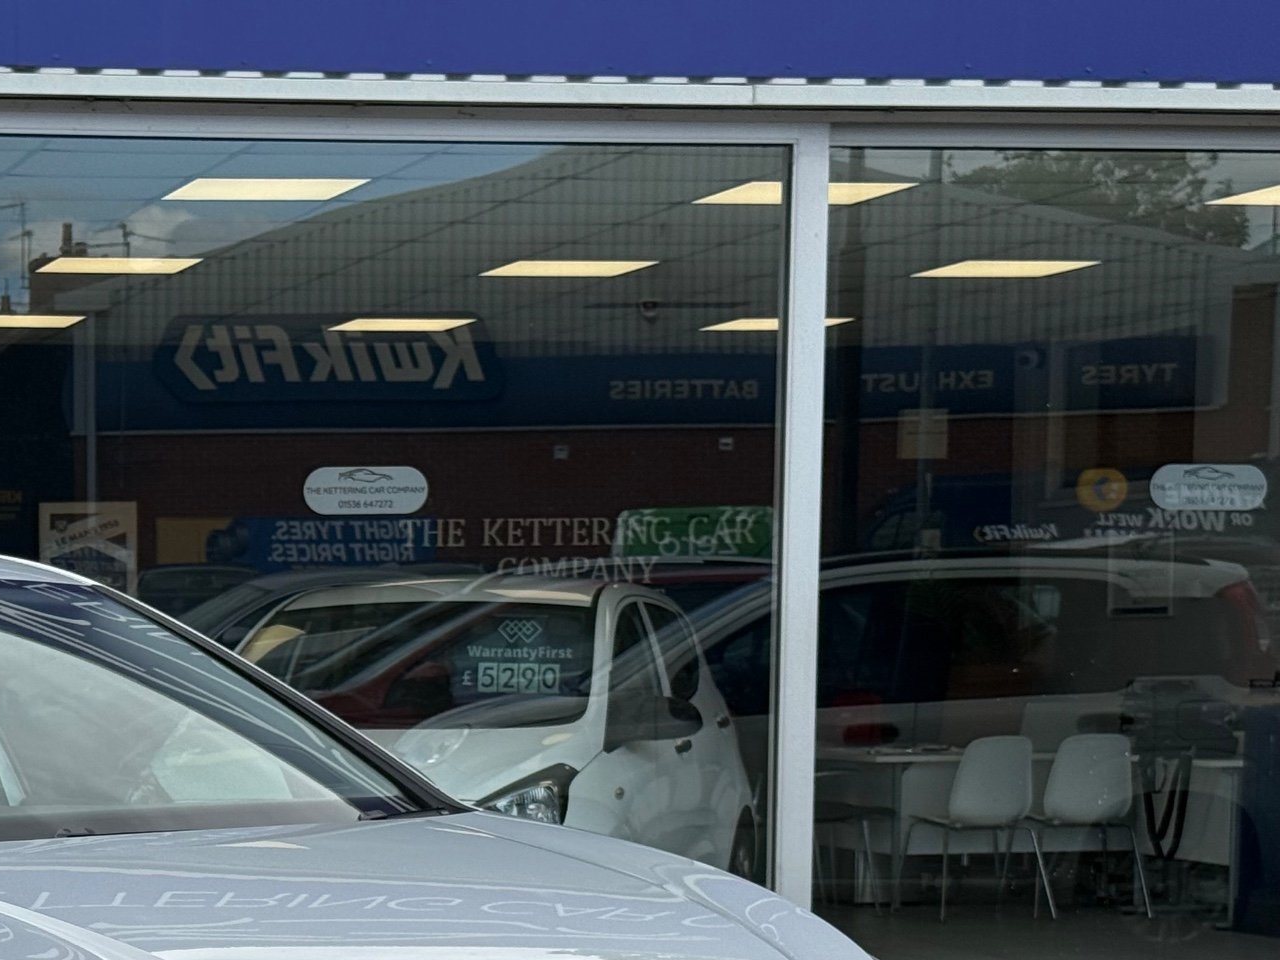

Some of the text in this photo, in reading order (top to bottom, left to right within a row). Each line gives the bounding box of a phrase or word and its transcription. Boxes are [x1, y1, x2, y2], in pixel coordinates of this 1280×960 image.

[306, 486, 426, 495] THE KETTERING CAR COMPANY
[338, 500, 394, 509] 01536 647272
[400, 516, 755, 548] THE KETTERING CAR
[498, 556, 661, 584] COMPANY
[467, 645, 573, 661] WarrantyFirst
